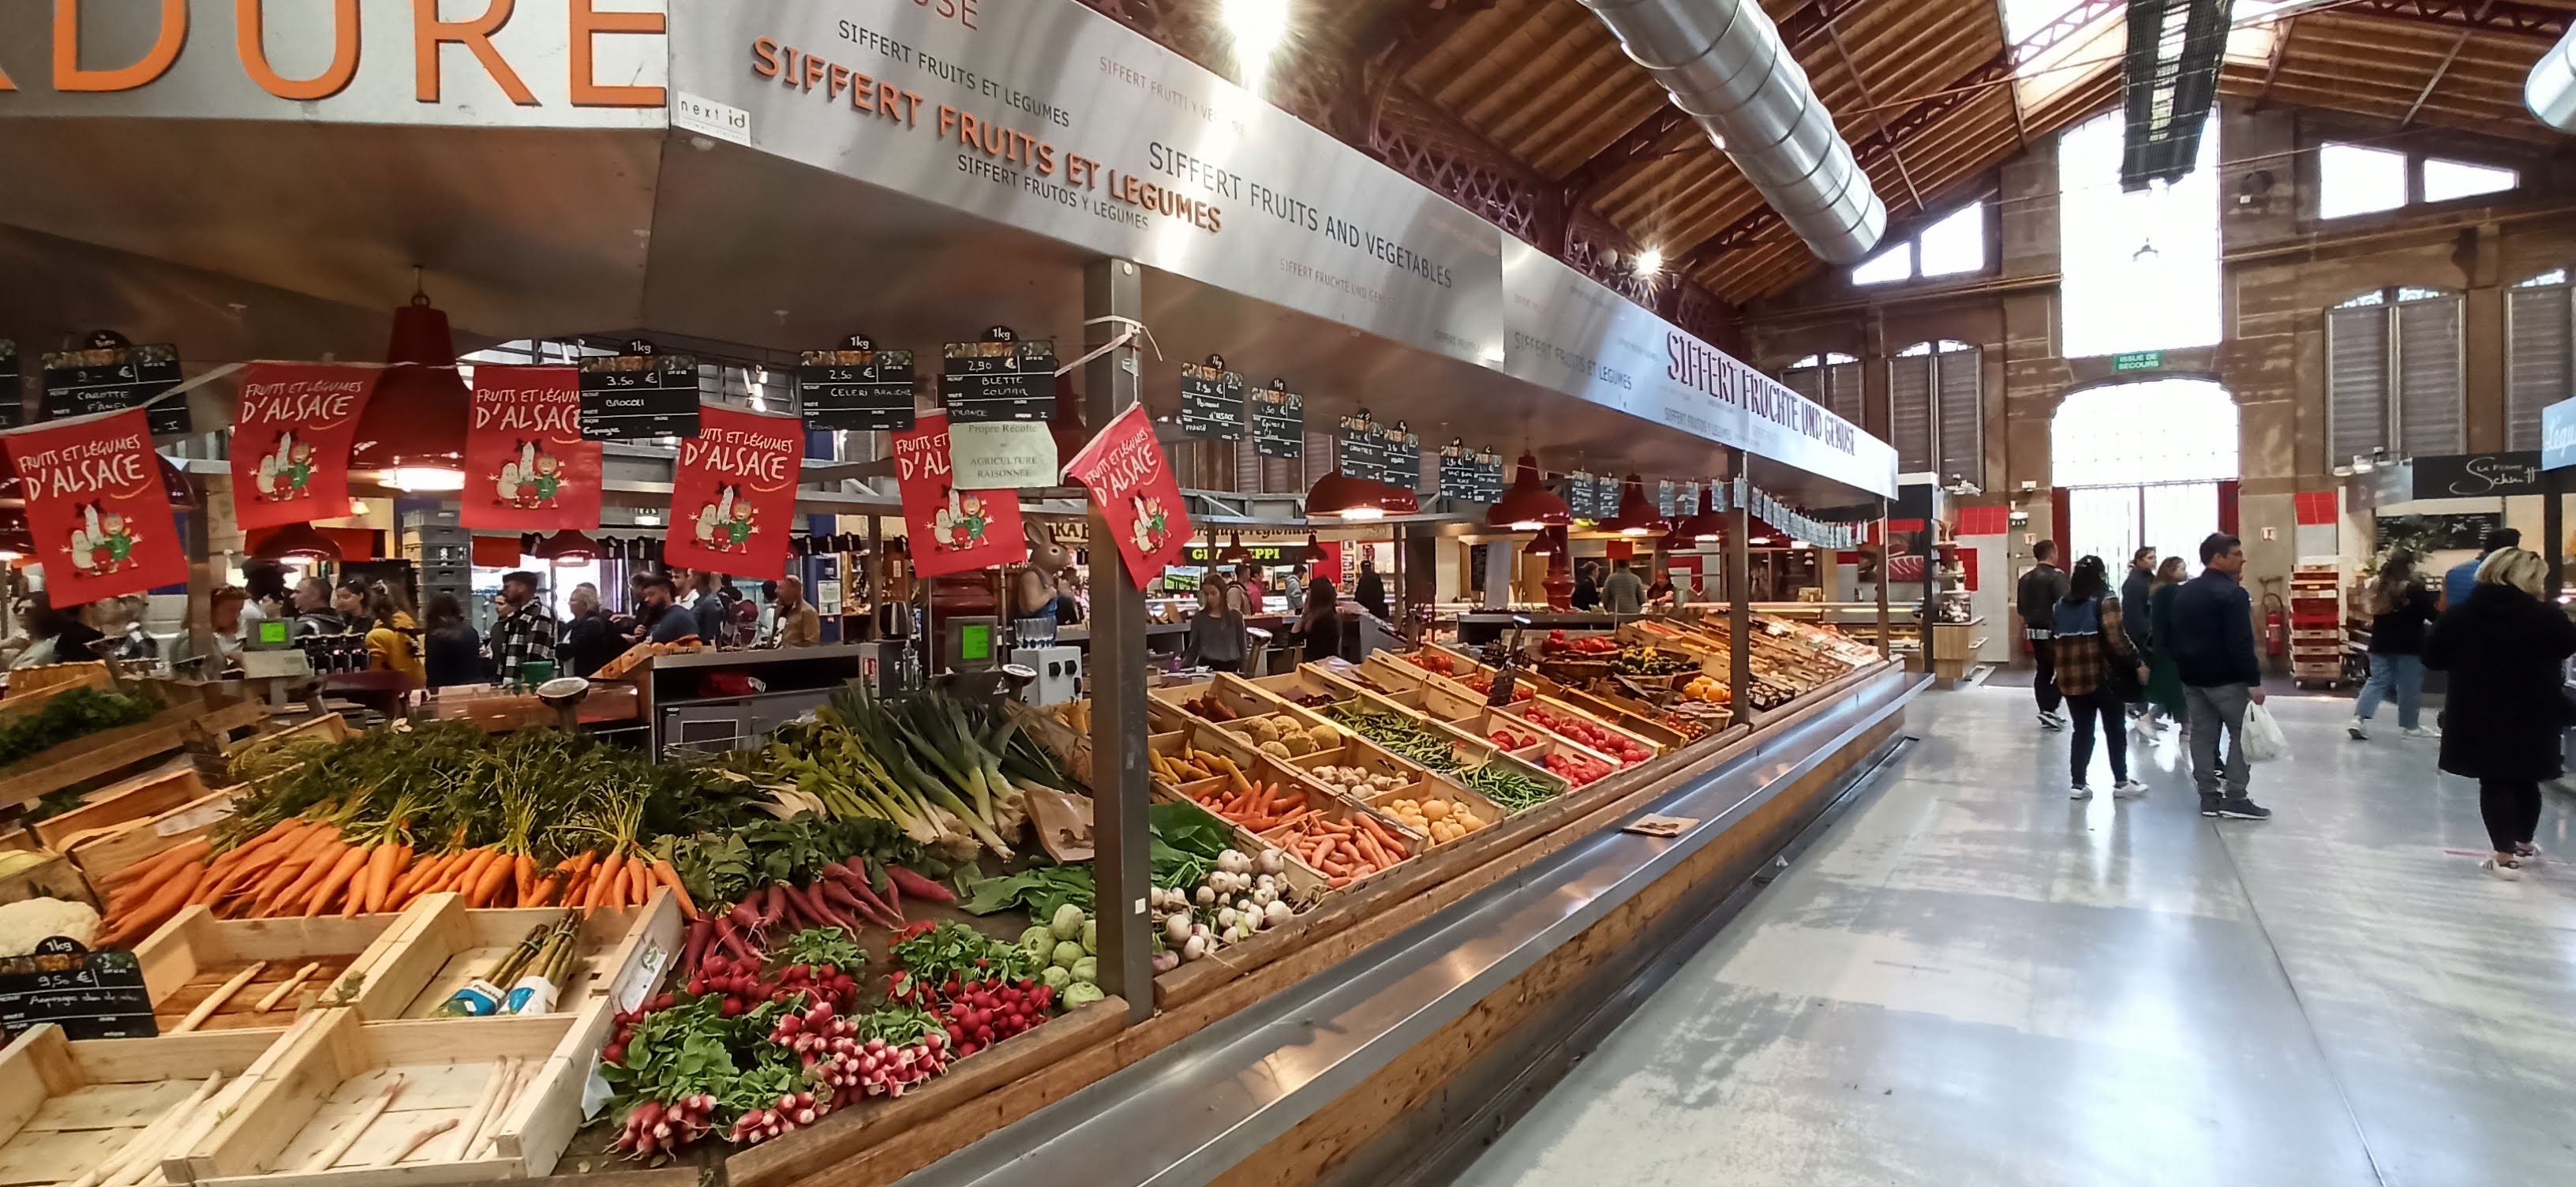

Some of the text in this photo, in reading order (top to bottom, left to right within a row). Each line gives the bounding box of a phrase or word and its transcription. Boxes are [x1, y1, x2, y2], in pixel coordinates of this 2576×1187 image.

[0, 0, 667, 107] DURE
[839, 20, 1069, 127] SIFFERT FRUITS ET LEGUMES
[1099, 56, 1147, 88] SIFFERT
[681, 100, 745, 128] next id
[752, 36, 1222, 234] SIFFERT FRUITS ET LEGUMES
[957, 154, 1149, 230] SIFFERT FRUTOS Y LEGUMES
[1148, 141, 1451, 289] SIFFERT FRUITS AND VEGETABLES
[1279, 259, 1312, 277] SIFFERT
[851, 335, 870, 350] 1kg
[992, 328, 1011, 340] 1kg
[631, 340, 651, 354] 1kg
[118, 366, 133, 378] €
[863, 367, 875, 378] €
[968, 358, 1017, 373] 2,90 €
[2118, 361, 2159, 369] SECOURS
[645, 373, 657, 384] €
[981, 376, 1024, 385] BLETTE
[1667, 331, 1737, 404] SIFFERT
[1742, 369, 1799, 432] FRUCHTE
[1800, 401, 1822, 440] UND
[245, 380, 363, 398] FRUITS ET LÉGUMES
[477, 388, 580, 403] FRUITS ET LÉGUM
[830, 388, 868, 397] CELERI
[242, 394, 354, 424] D'ALSACE
[968, 424, 1001, 435] Propre
[698, 428, 794, 454] UITS ET LÉGUMES
[896, 432, 948, 455] FRUITS ET
[18, 434, 140, 473] FRUITS ET LÉGUMES
[684, 441, 788, 482] D'ALSACE
[970, 456, 1038, 466] AGRICULTURE
[900, 451, 950, 481] D'AL
[1084, 458, 1110, 486] FRUITS
[1109, 450, 1120, 465] ET
[1093, 444, 1156, 507] D'ALSACE
[26, 454, 144, 501] D'ALSACE
[46, 939, 73, 952] 1kg
[76, 971, 93, 983] €
